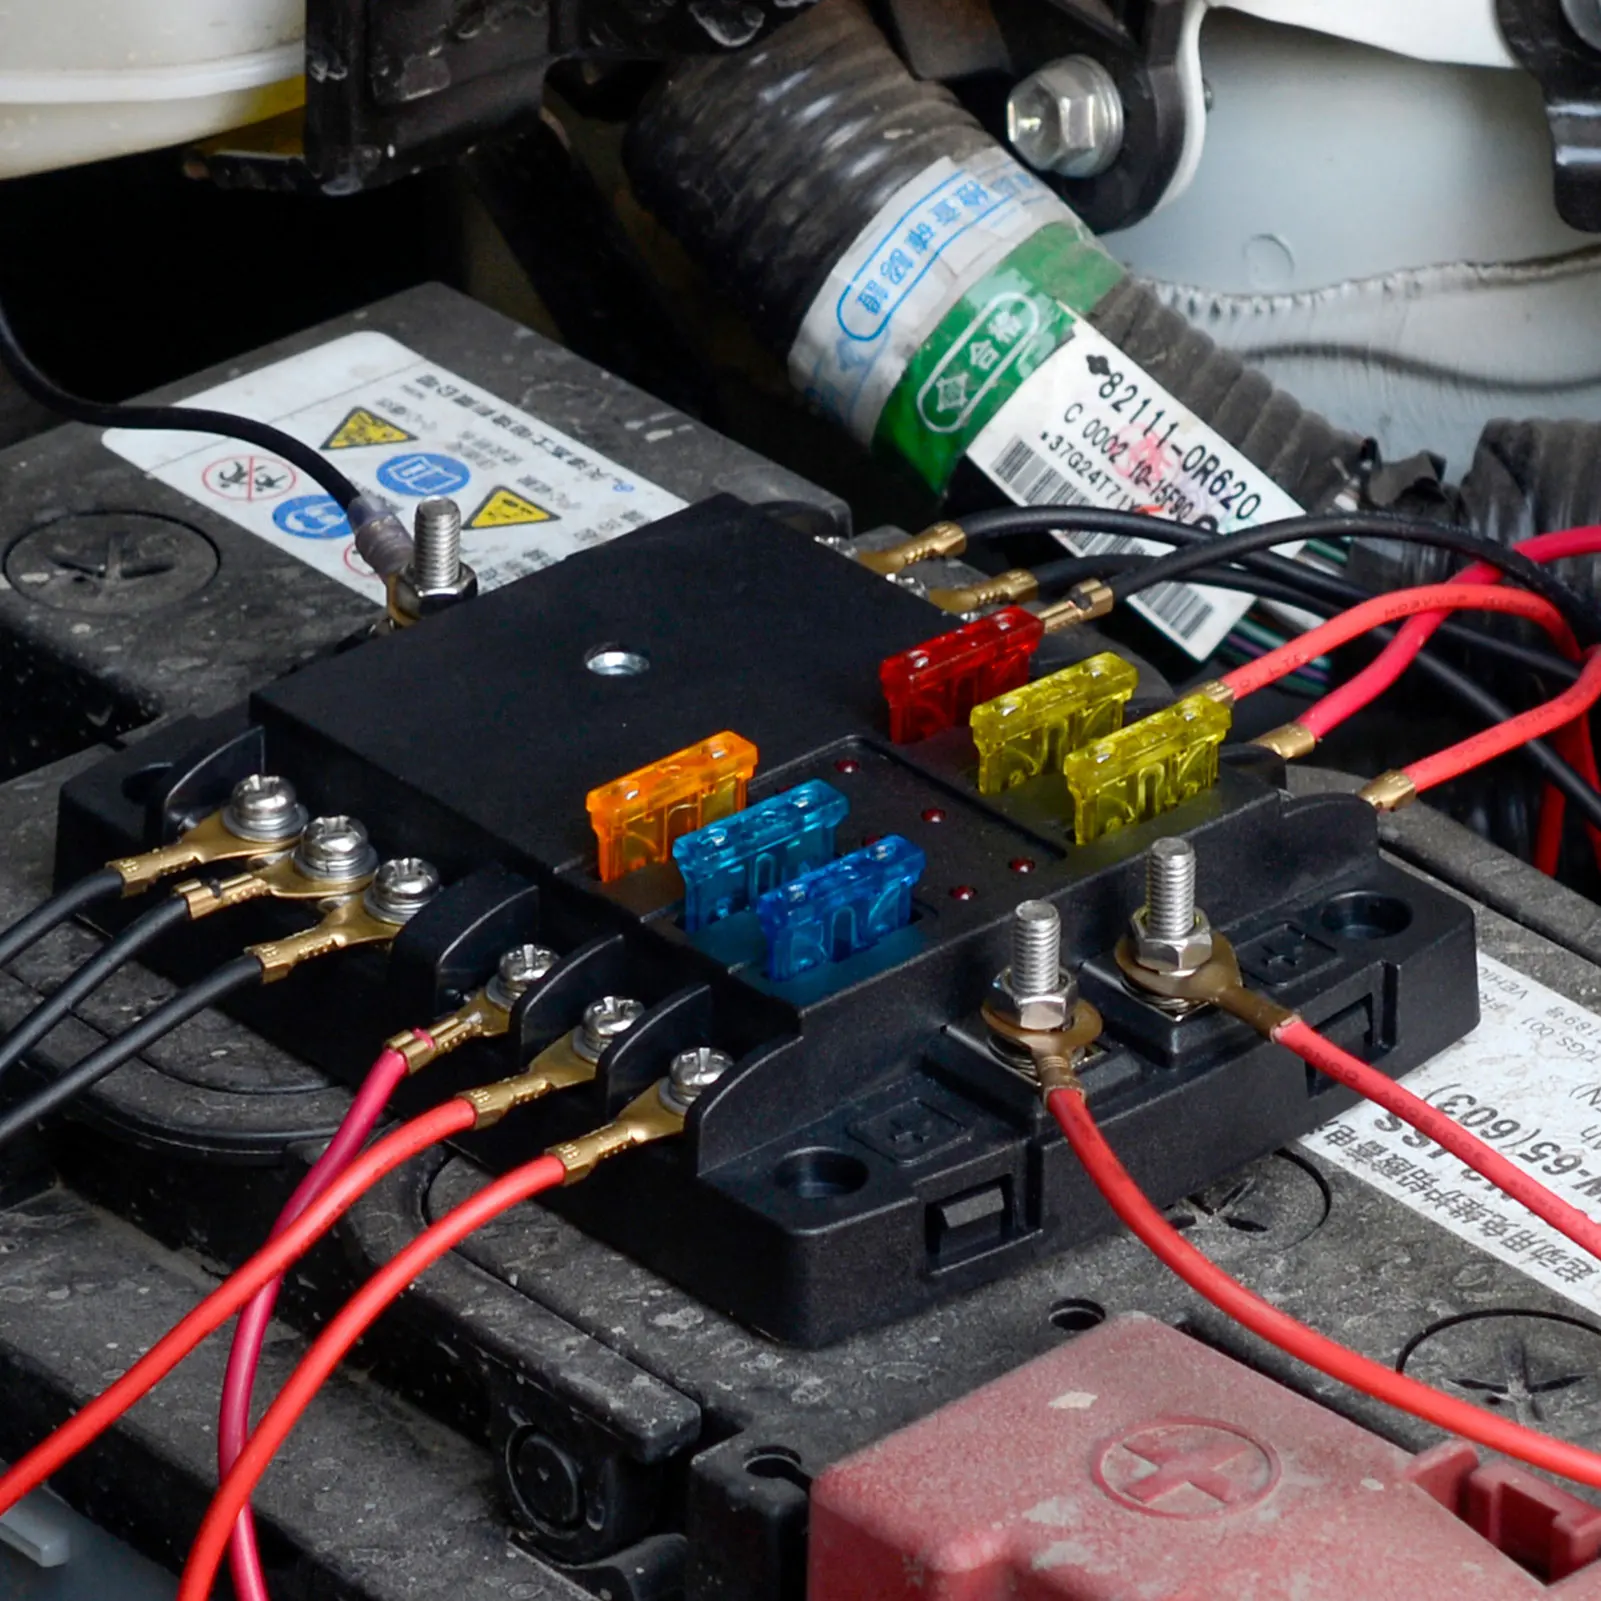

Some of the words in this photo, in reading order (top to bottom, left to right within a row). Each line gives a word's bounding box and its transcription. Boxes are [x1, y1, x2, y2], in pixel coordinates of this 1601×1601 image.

[1063, 402, 1084, 425] C
[1081, 418, 1130, 464] 0002
[1098, 371, 1262, 520] 82111-0R620
